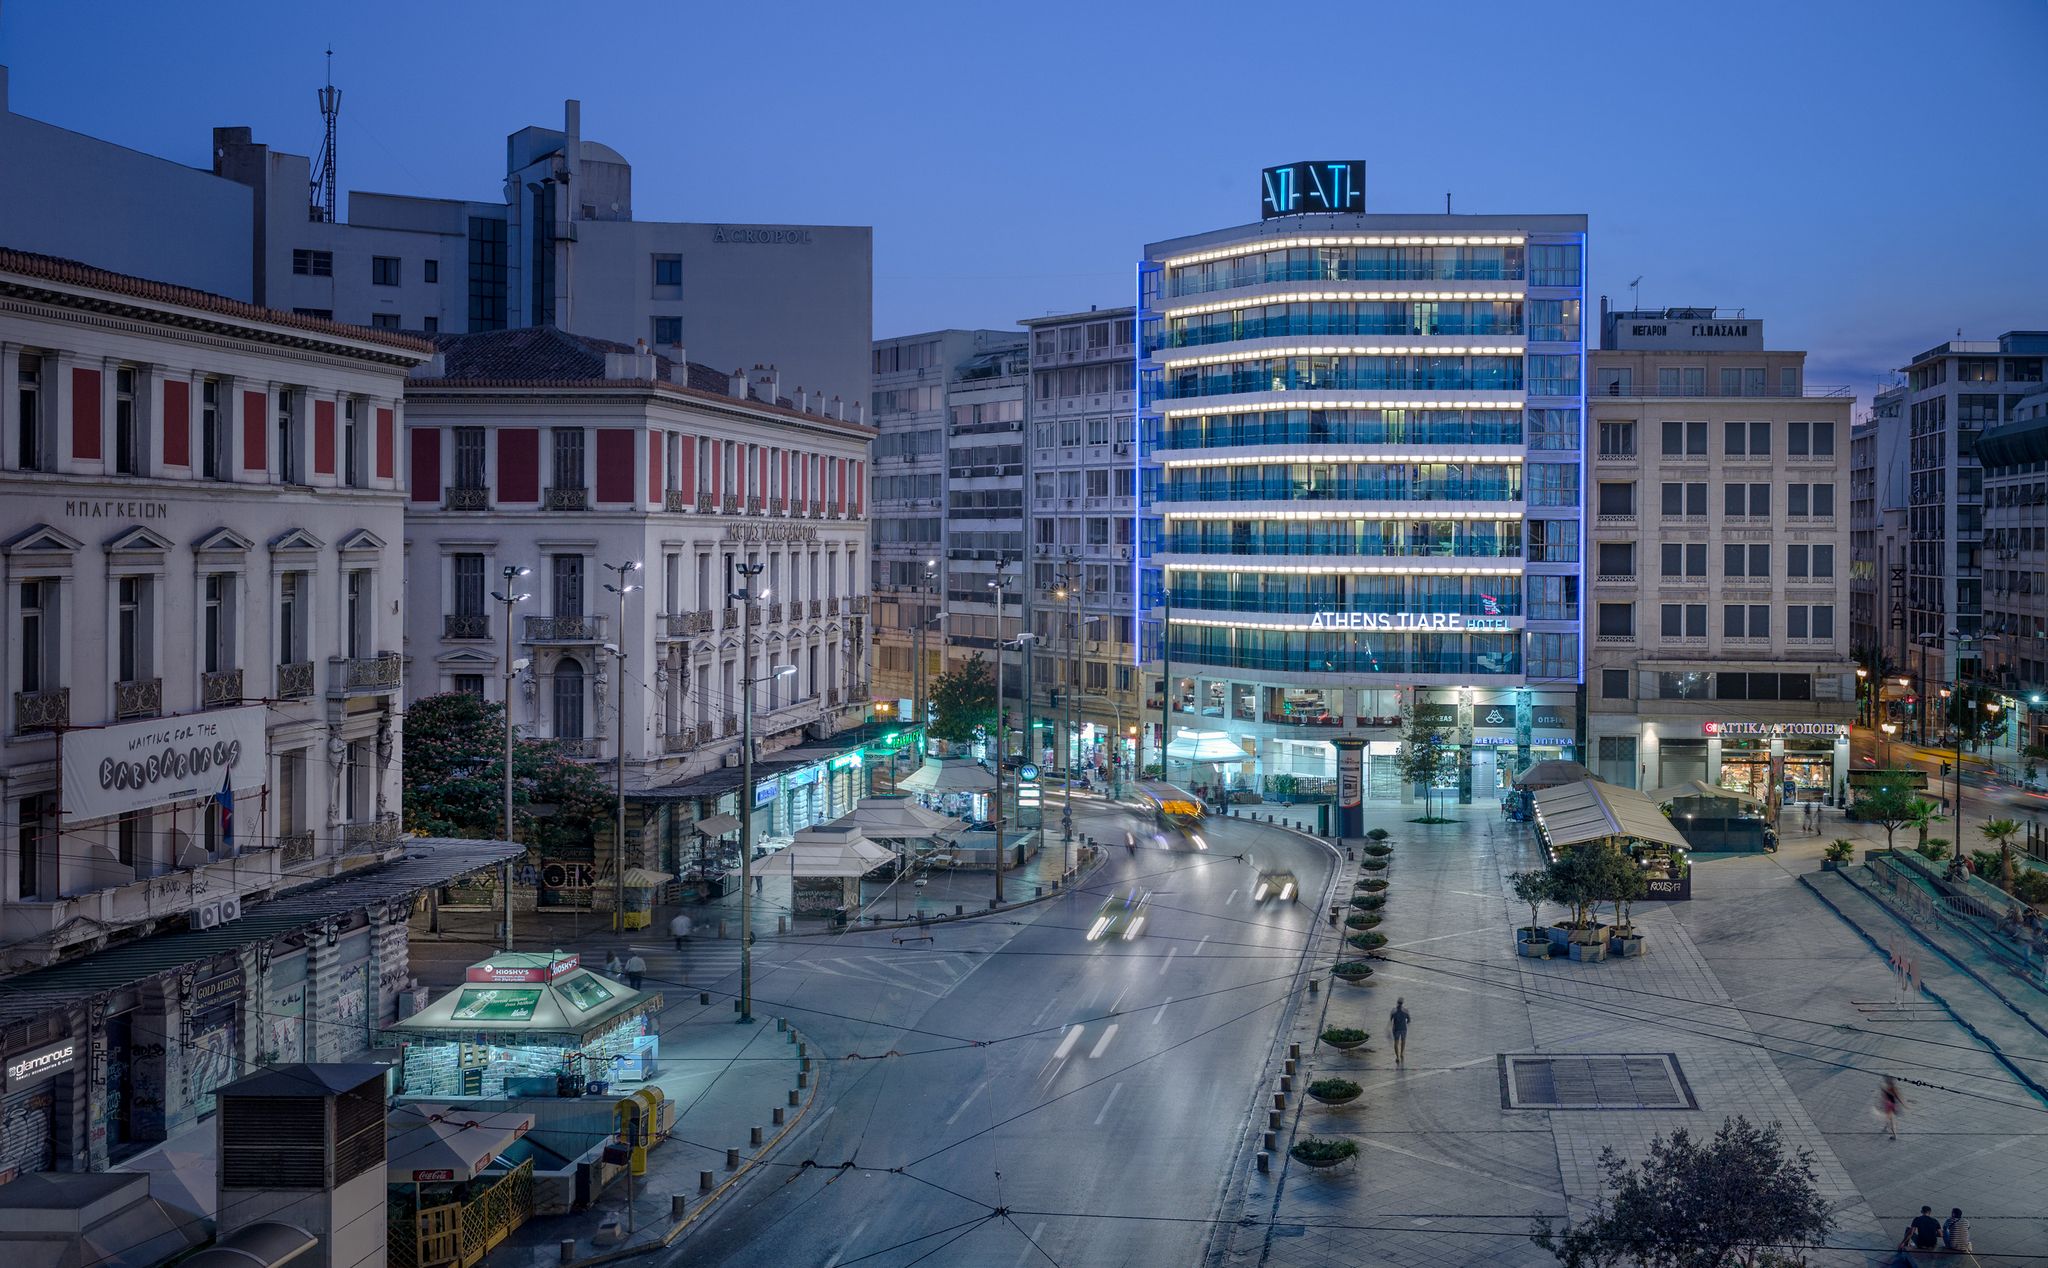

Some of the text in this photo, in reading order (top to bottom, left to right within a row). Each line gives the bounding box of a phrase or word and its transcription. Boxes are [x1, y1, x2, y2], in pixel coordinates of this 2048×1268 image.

[713, 226, 813, 243] ACROPOL
[66, 501, 167, 519] ΜΠΑΓΚΕΙΟΝ
[1311, 612, 1511, 631] ATHENS TIARE HOTEL
[128, 723, 217, 751] WAITING FOR THE
[1719, 723, 1849, 735] ΑΤΤΙΚΑ ΑΡΤΟΠΟΙΕΙΑ
[99, 739, 242, 790] BARBARIANS
[198, 974, 240, 999] GOLD ATHENS
[16, 1046, 73, 1077] glamorous
